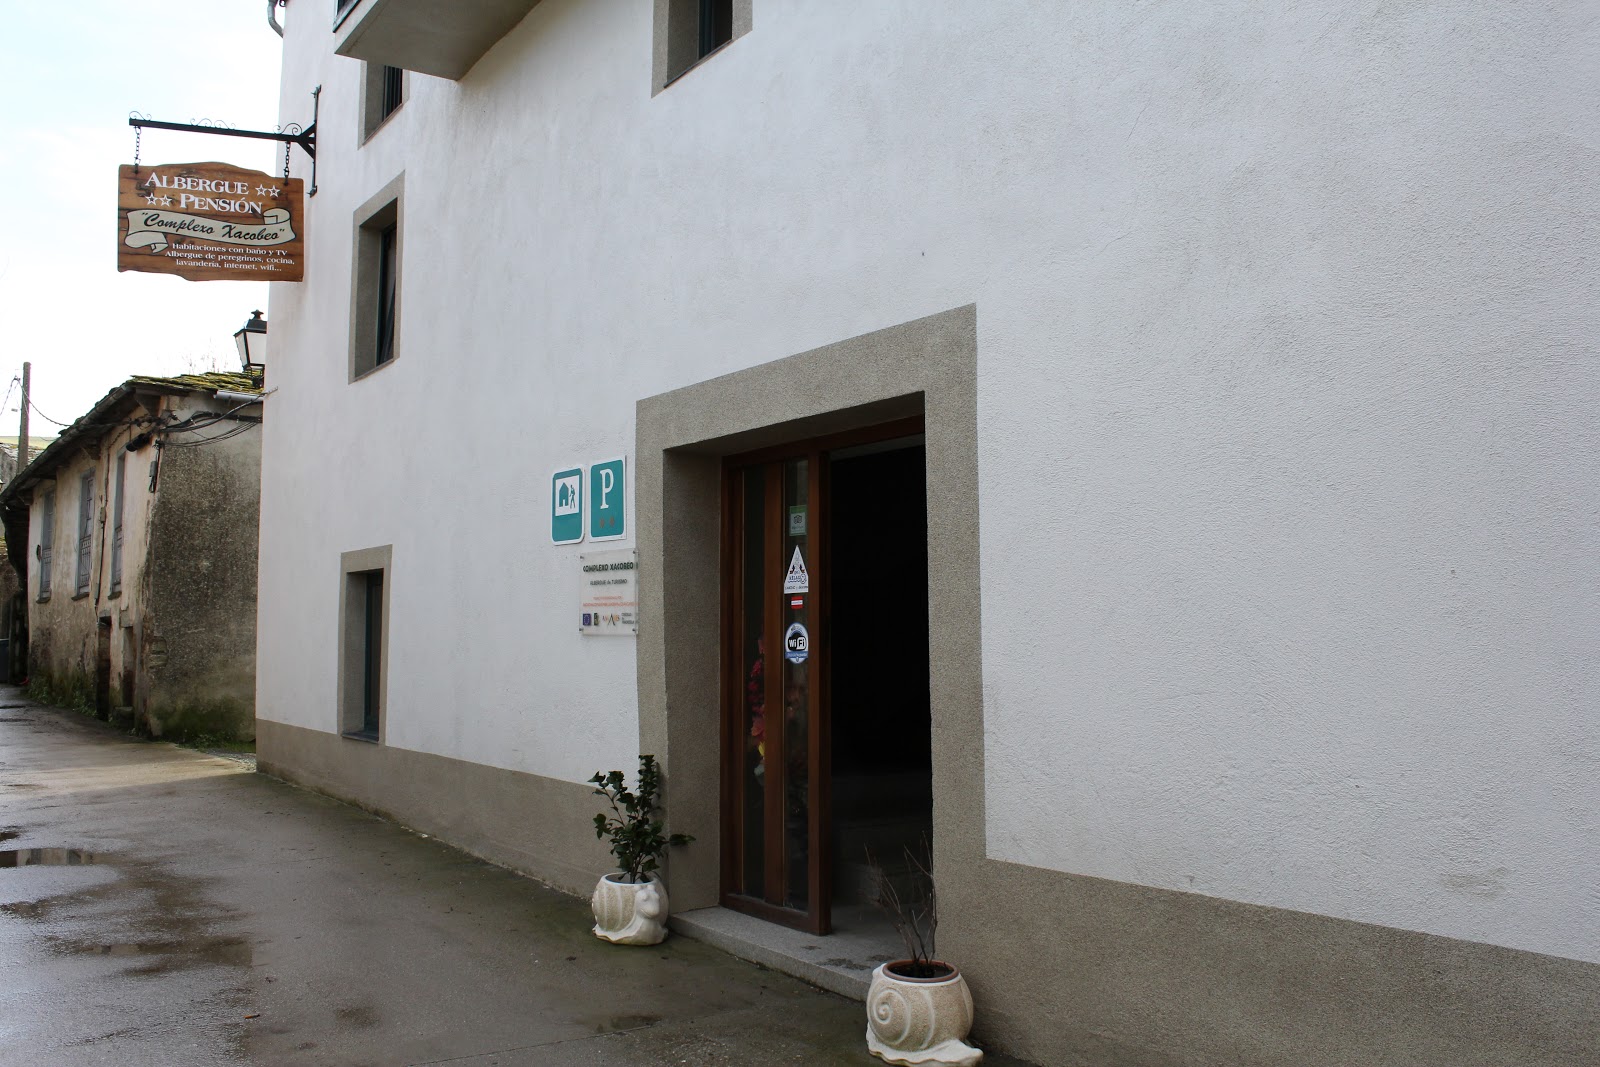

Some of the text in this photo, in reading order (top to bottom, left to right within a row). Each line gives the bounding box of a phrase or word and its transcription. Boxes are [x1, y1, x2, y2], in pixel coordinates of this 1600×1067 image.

[145, 172, 249, 195] ALBERGUE
[179, 193, 262, 214] PENSIÓN
[141, 212, 285, 241] "Complexo Xacobeo"
[172, 243, 227, 253] Habitaciones
[246, 247, 267, 255] baño
[165, 251, 203, 259] Albergue
[218, 254, 264, 263] peregrinos,
[266, 257, 295, 265] cocina,
[176, 259, 221, 269] lavandería,
[224, 262, 258, 271] internet,
[600, 468, 614, 509] P
[582, 561, 634, 573] COMPLEXO XACOBEO
